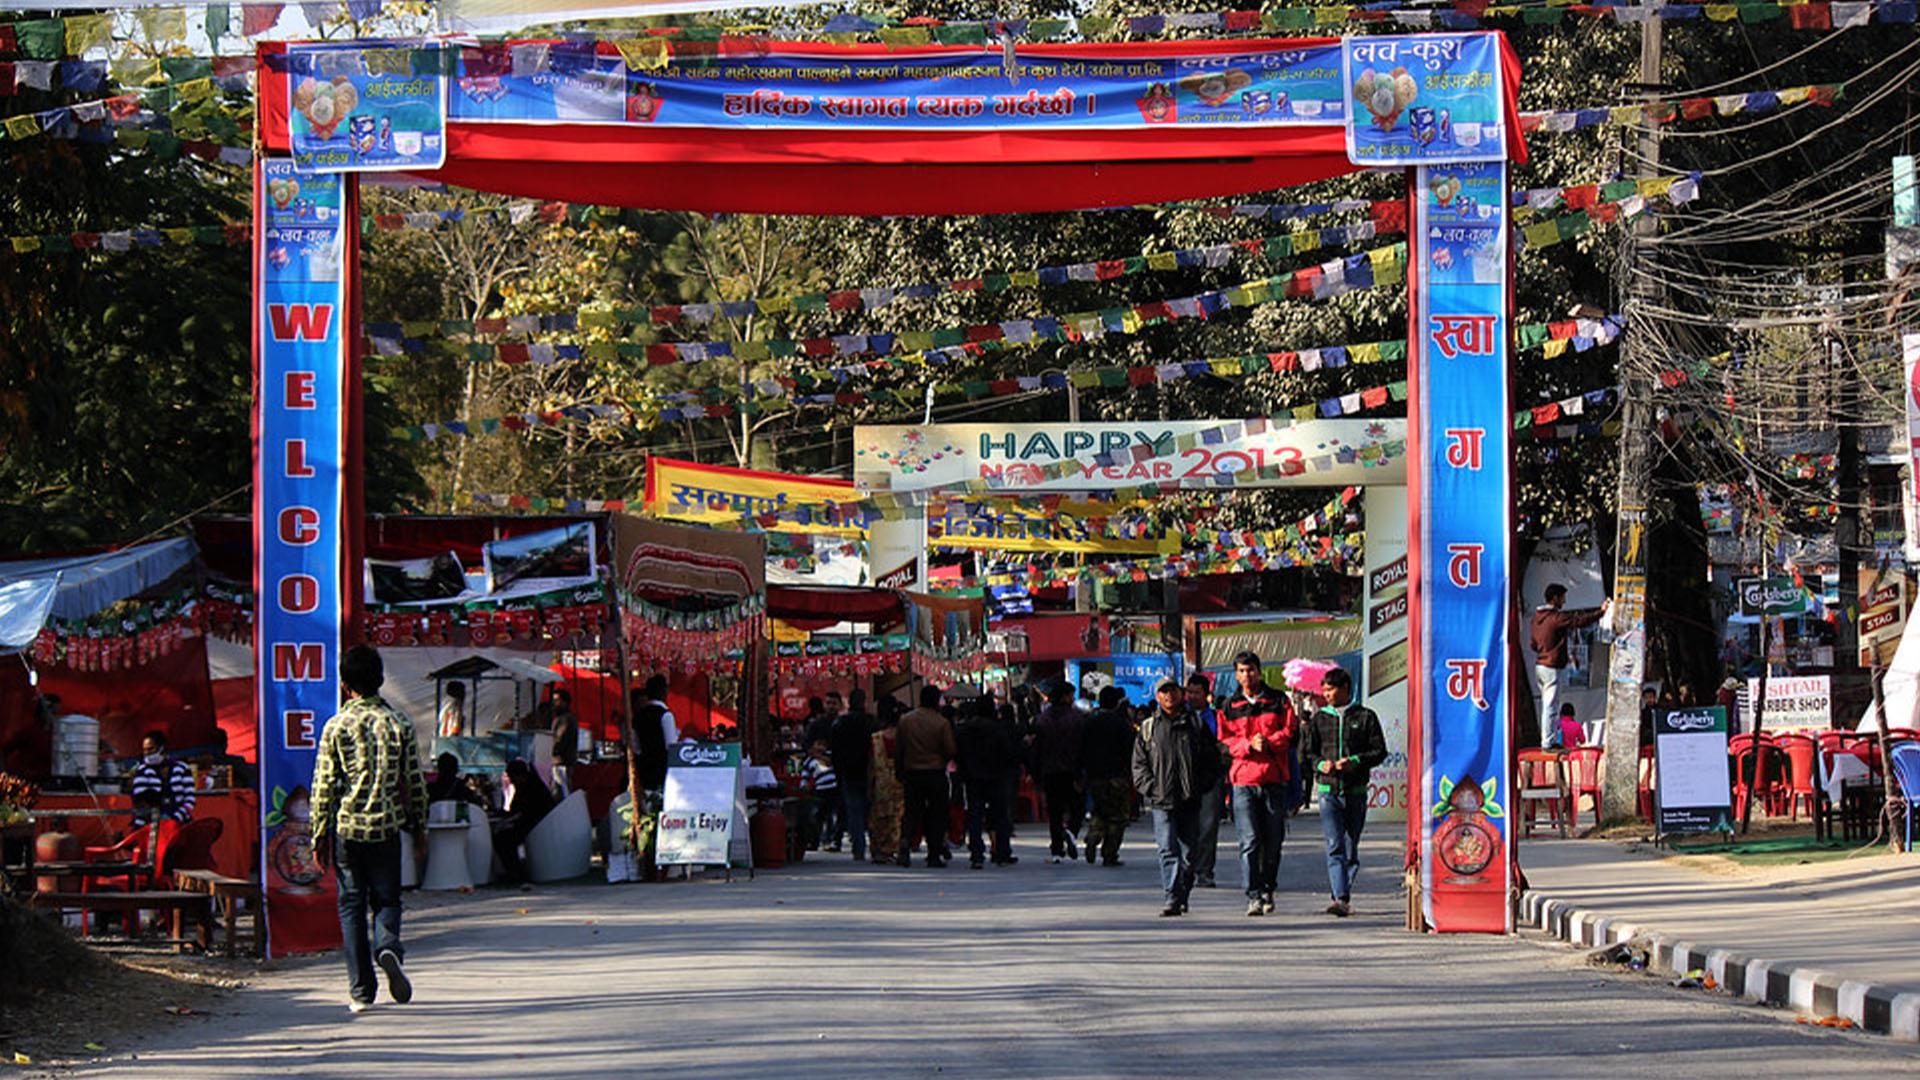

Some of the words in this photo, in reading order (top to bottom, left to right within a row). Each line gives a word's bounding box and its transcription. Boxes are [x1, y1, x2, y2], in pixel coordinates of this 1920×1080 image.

[723, 89, 813, 118] हार्दिक
[819, 95, 910, 118] स्वागत
[979, 430, 1174, 460] HAPPY
[1080, 461, 1174, 480] YEAR
[1181, 447, 1306, 478] 2013
[268, 303, 334, 750] WELCOME
[1376, 599, 1407, 625] STAG
[1115, 665, 1175, 677] RUSLAN
[1752, 698, 1796, 713] BRBER
[1799, 697, 1828, 711] SHOP
[699, 812, 728, 832] Enjoy
